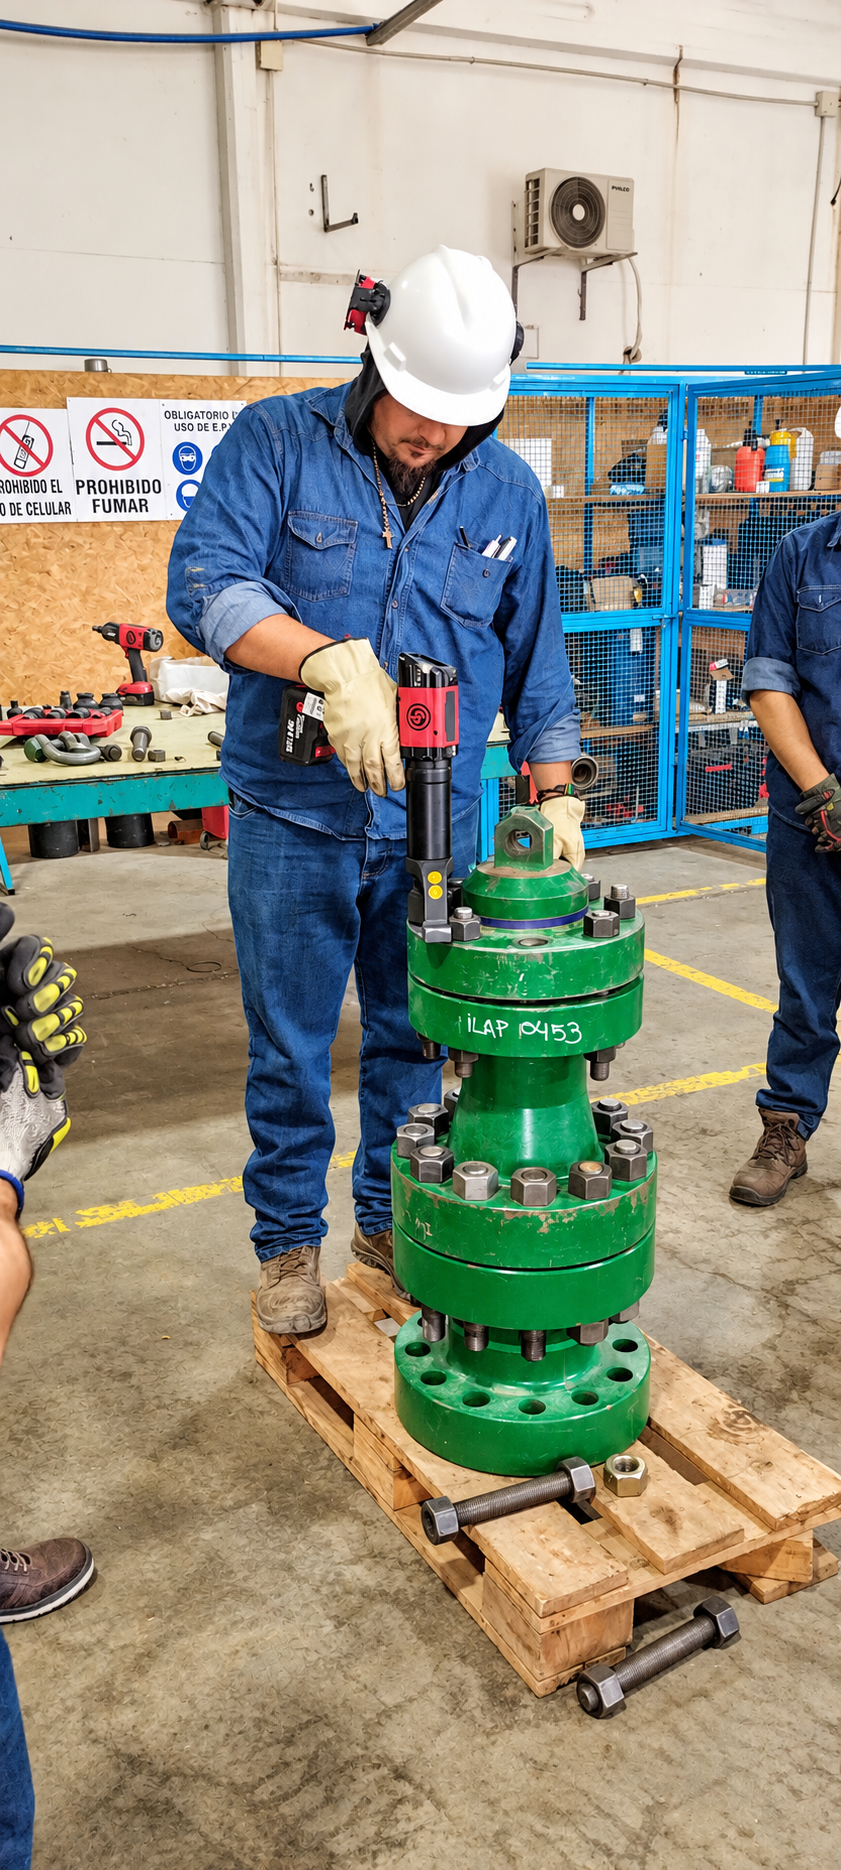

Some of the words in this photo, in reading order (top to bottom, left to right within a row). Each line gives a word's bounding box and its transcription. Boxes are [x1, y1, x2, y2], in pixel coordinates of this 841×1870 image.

[164, 410, 229, 420] OBLIGATORIO
[174, 422, 194, 432] USO
[197, 422, 210, 432] DE
[212, 422, 232, 432] E.P
[50, 479, 63, 493] EL
[75, 479, 162, 495] PROHIBIDO
[9, 502, 23, 516] DE
[26, 501, 72, 516] CELULAR
[92, 498, 149, 514] FUMAR
